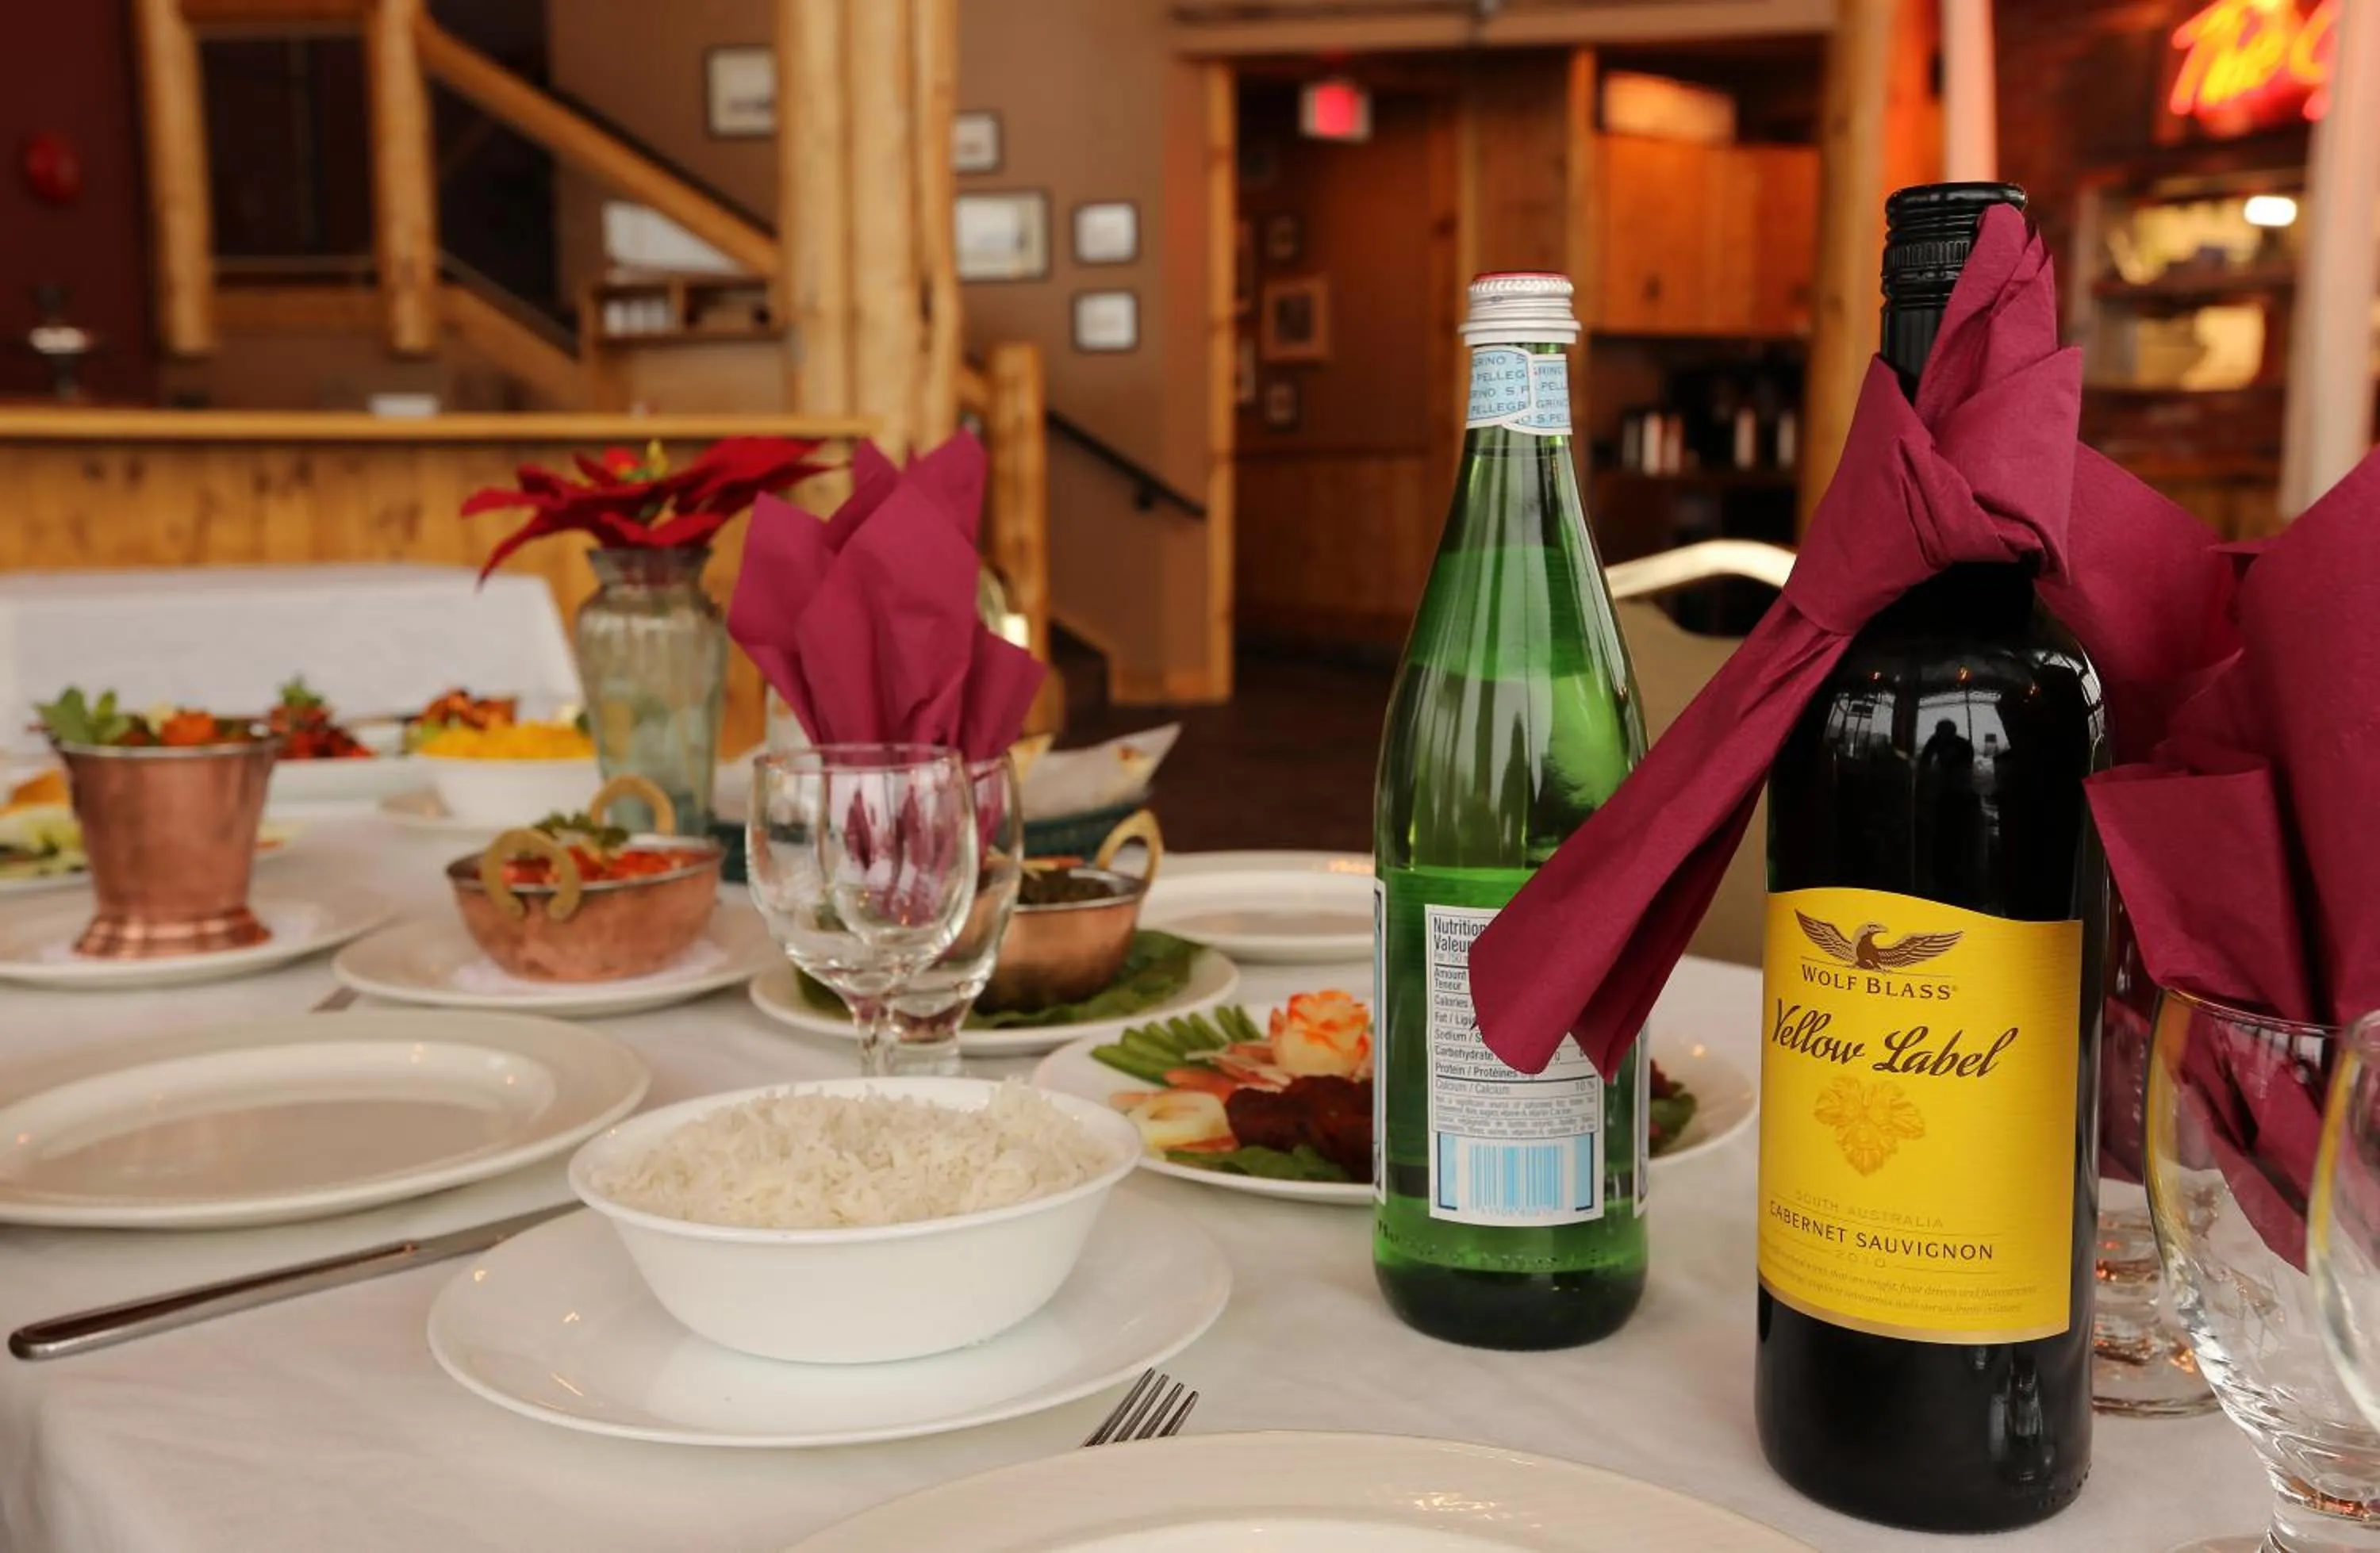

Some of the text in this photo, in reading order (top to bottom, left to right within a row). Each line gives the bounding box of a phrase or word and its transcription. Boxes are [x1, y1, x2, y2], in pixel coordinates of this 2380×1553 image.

[1434, 967, 1467, 980] Amount
[1434, 978, 1462, 991] Teneur
[1801, 963, 1952, 1001] WOLF BLASS
[1434, 995, 1468, 1008] Calories
[1434, 1011, 1448, 1023] Fat
[1434, 1029, 1467, 1041] Sodium
[1771, 997, 2019, 1079] Yellow Label
[1435, 1063, 1465, 1076] Protein
[1475, 1083, 1511, 1095] Calcium
[1795, 1189, 1944, 1229] SOUTH AUSTRALIA
[1769, 1199, 1848, 1244] CABERNET
[1856, 1232, 1994, 1260] SAUVIGNON
